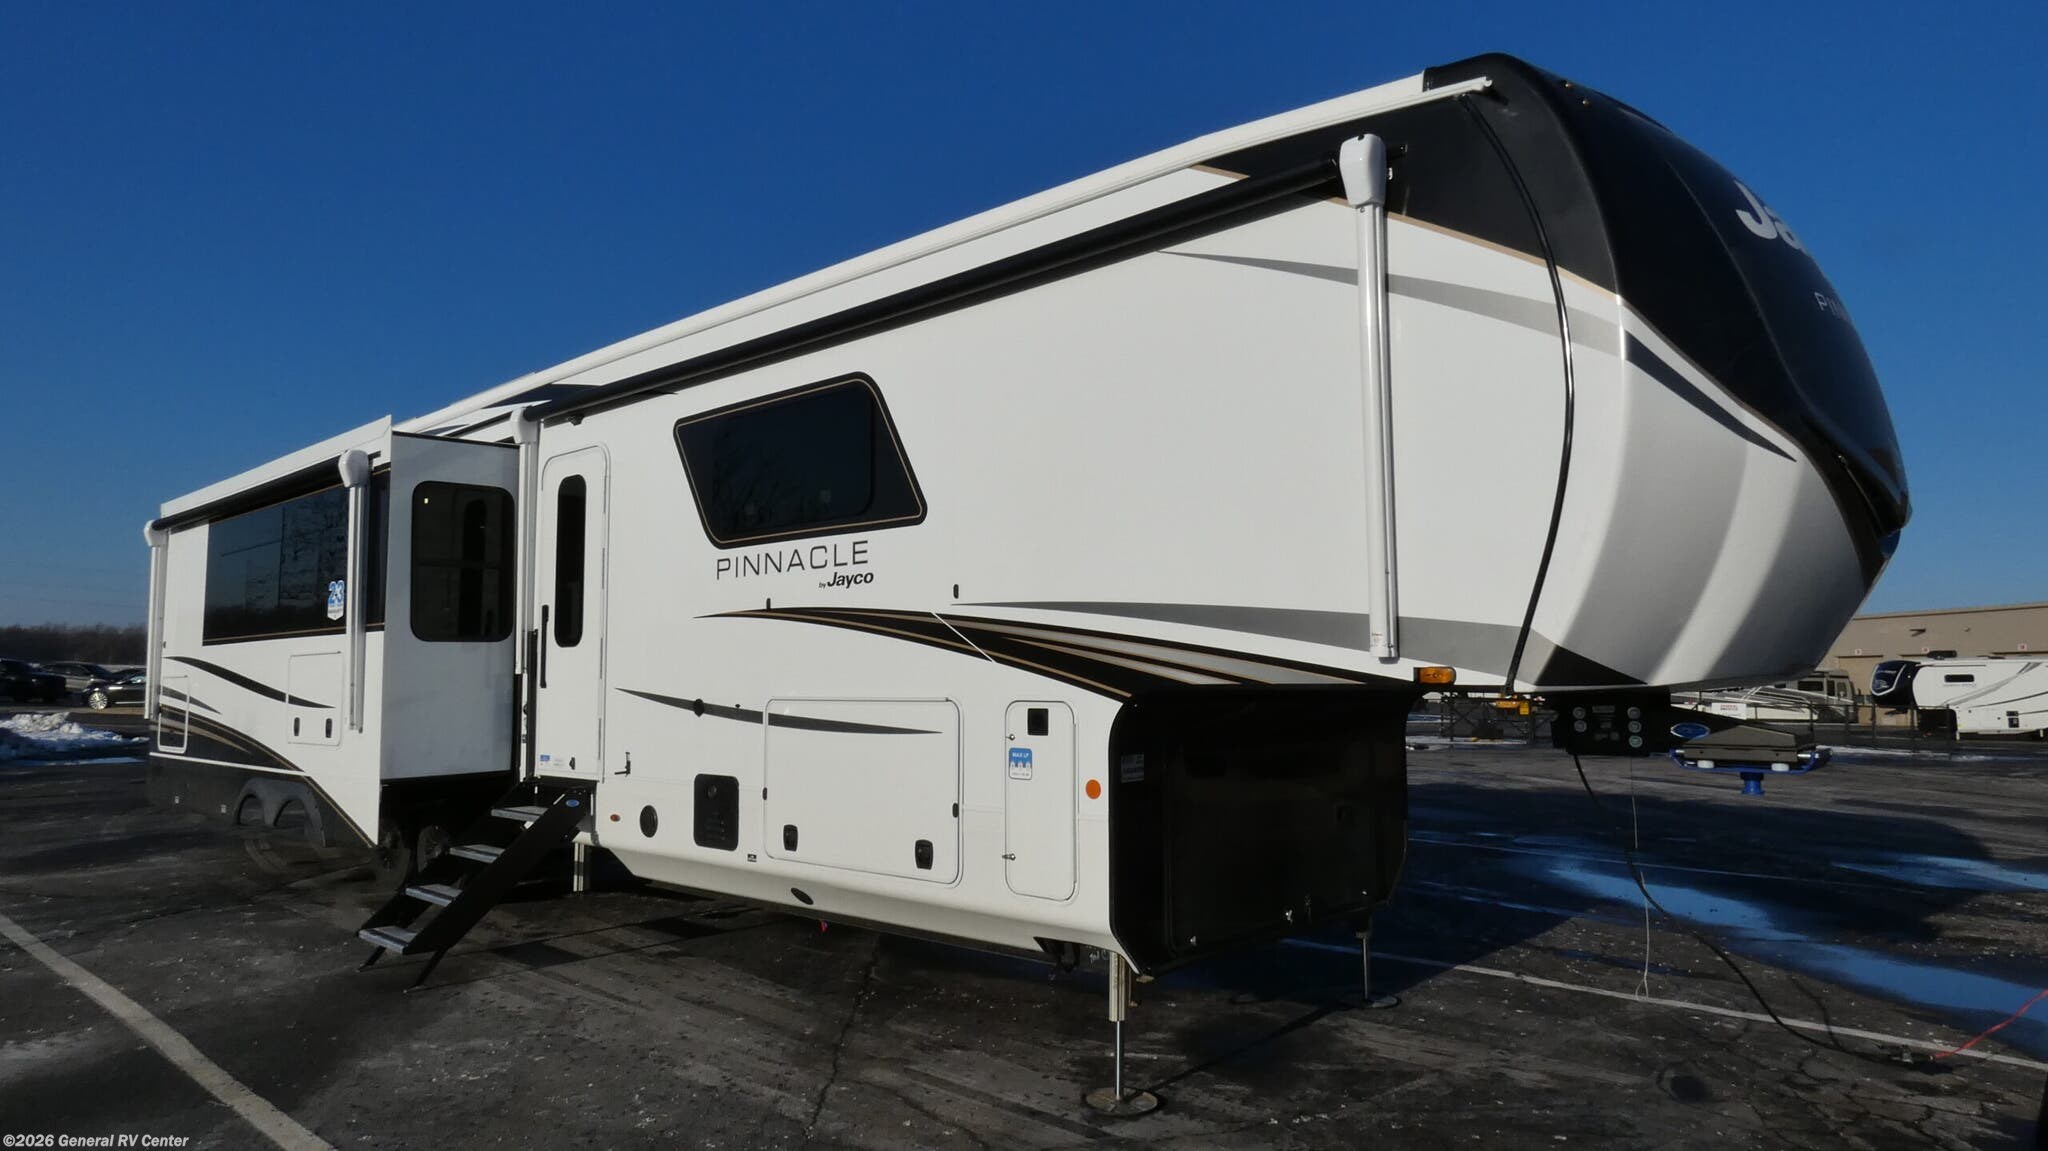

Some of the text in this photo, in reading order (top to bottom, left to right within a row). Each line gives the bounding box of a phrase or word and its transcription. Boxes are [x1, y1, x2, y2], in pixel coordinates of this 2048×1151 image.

[1733, 180, 1810, 257] Ja
[717, 541, 868, 580] PINNACLE
[818, 572, 874, 589] by Jayco
